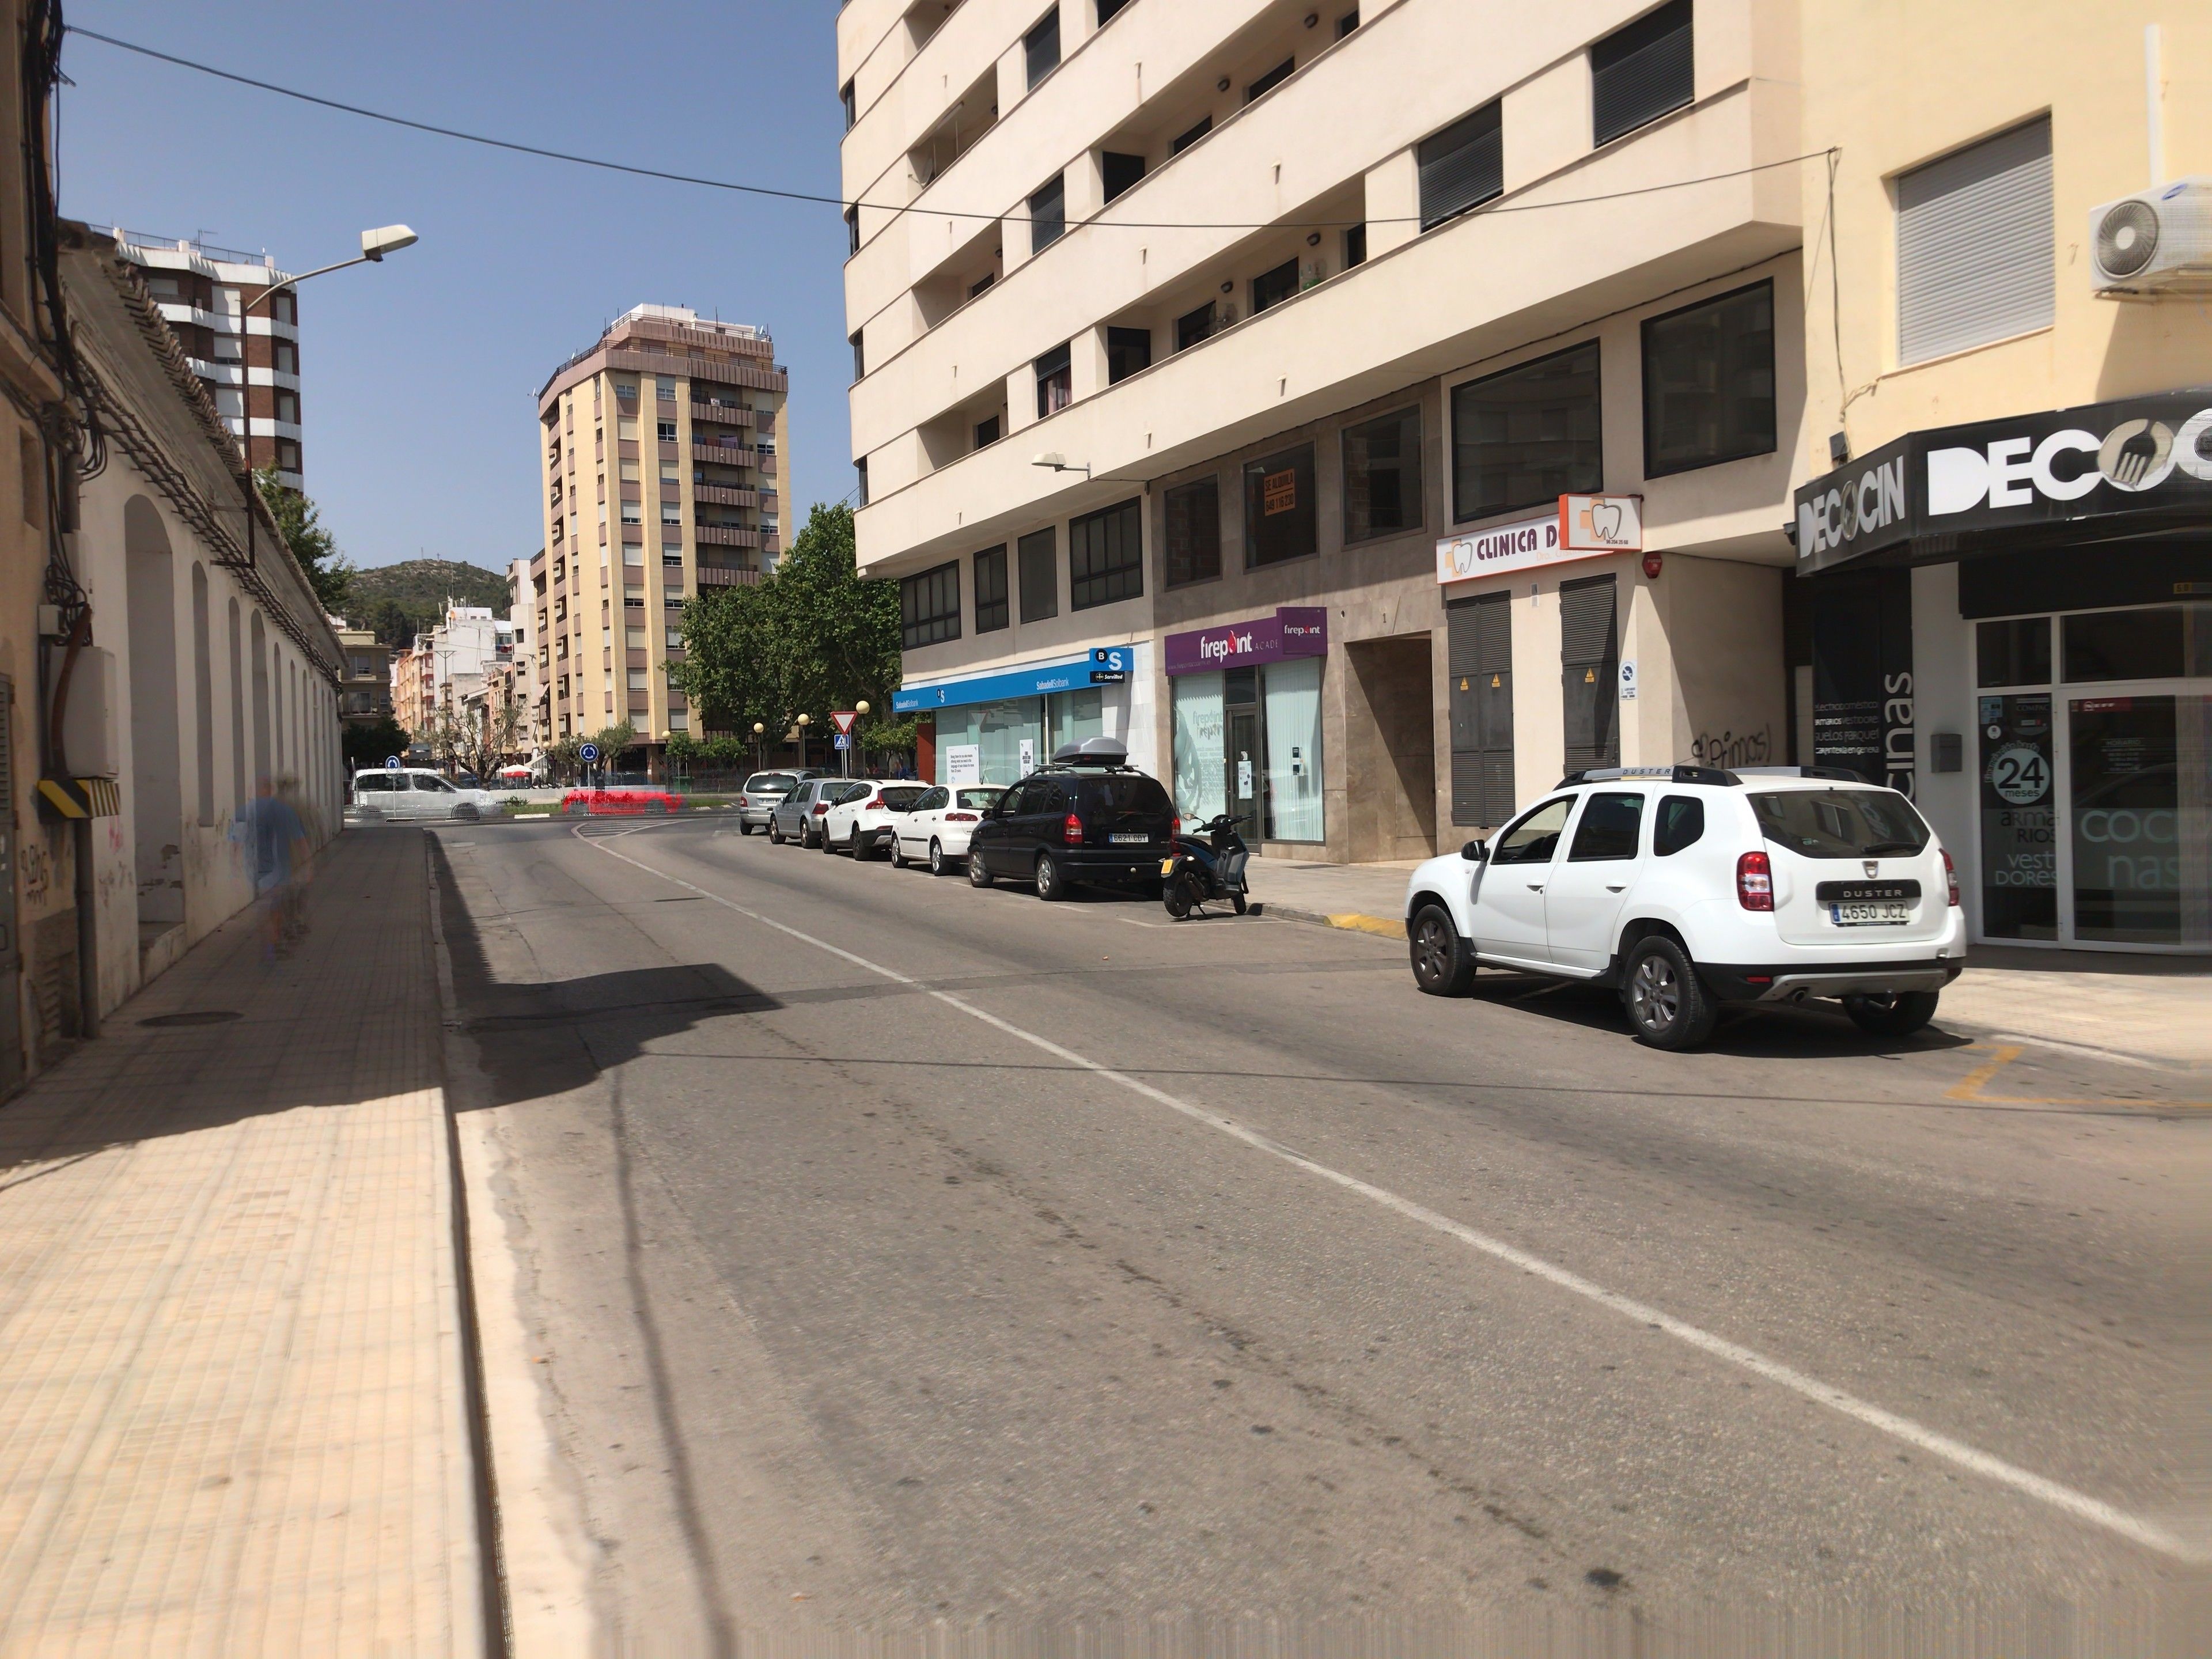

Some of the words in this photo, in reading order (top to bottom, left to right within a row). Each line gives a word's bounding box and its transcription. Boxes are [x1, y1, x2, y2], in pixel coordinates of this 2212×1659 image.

[1272, 472, 1294, 488] ALQUILA
[1798, 455, 1905, 559] DECOCIN
[1477, 528, 1537, 560] CLINICA
[1285, 624, 1321, 637] firepoint
[1200, 630, 1252, 663] firepoint
[1098, 652, 1105, 660] B
[1108, 652, 1123, 671] S
[1998, 757, 2044, 789] 24
[2005, 789, 2040, 797] meses
[1843, 889, 1903, 898] DUSTER
[1842, 903, 1878, 920] 4650
[1881, 903, 1907, 919] JCZ
